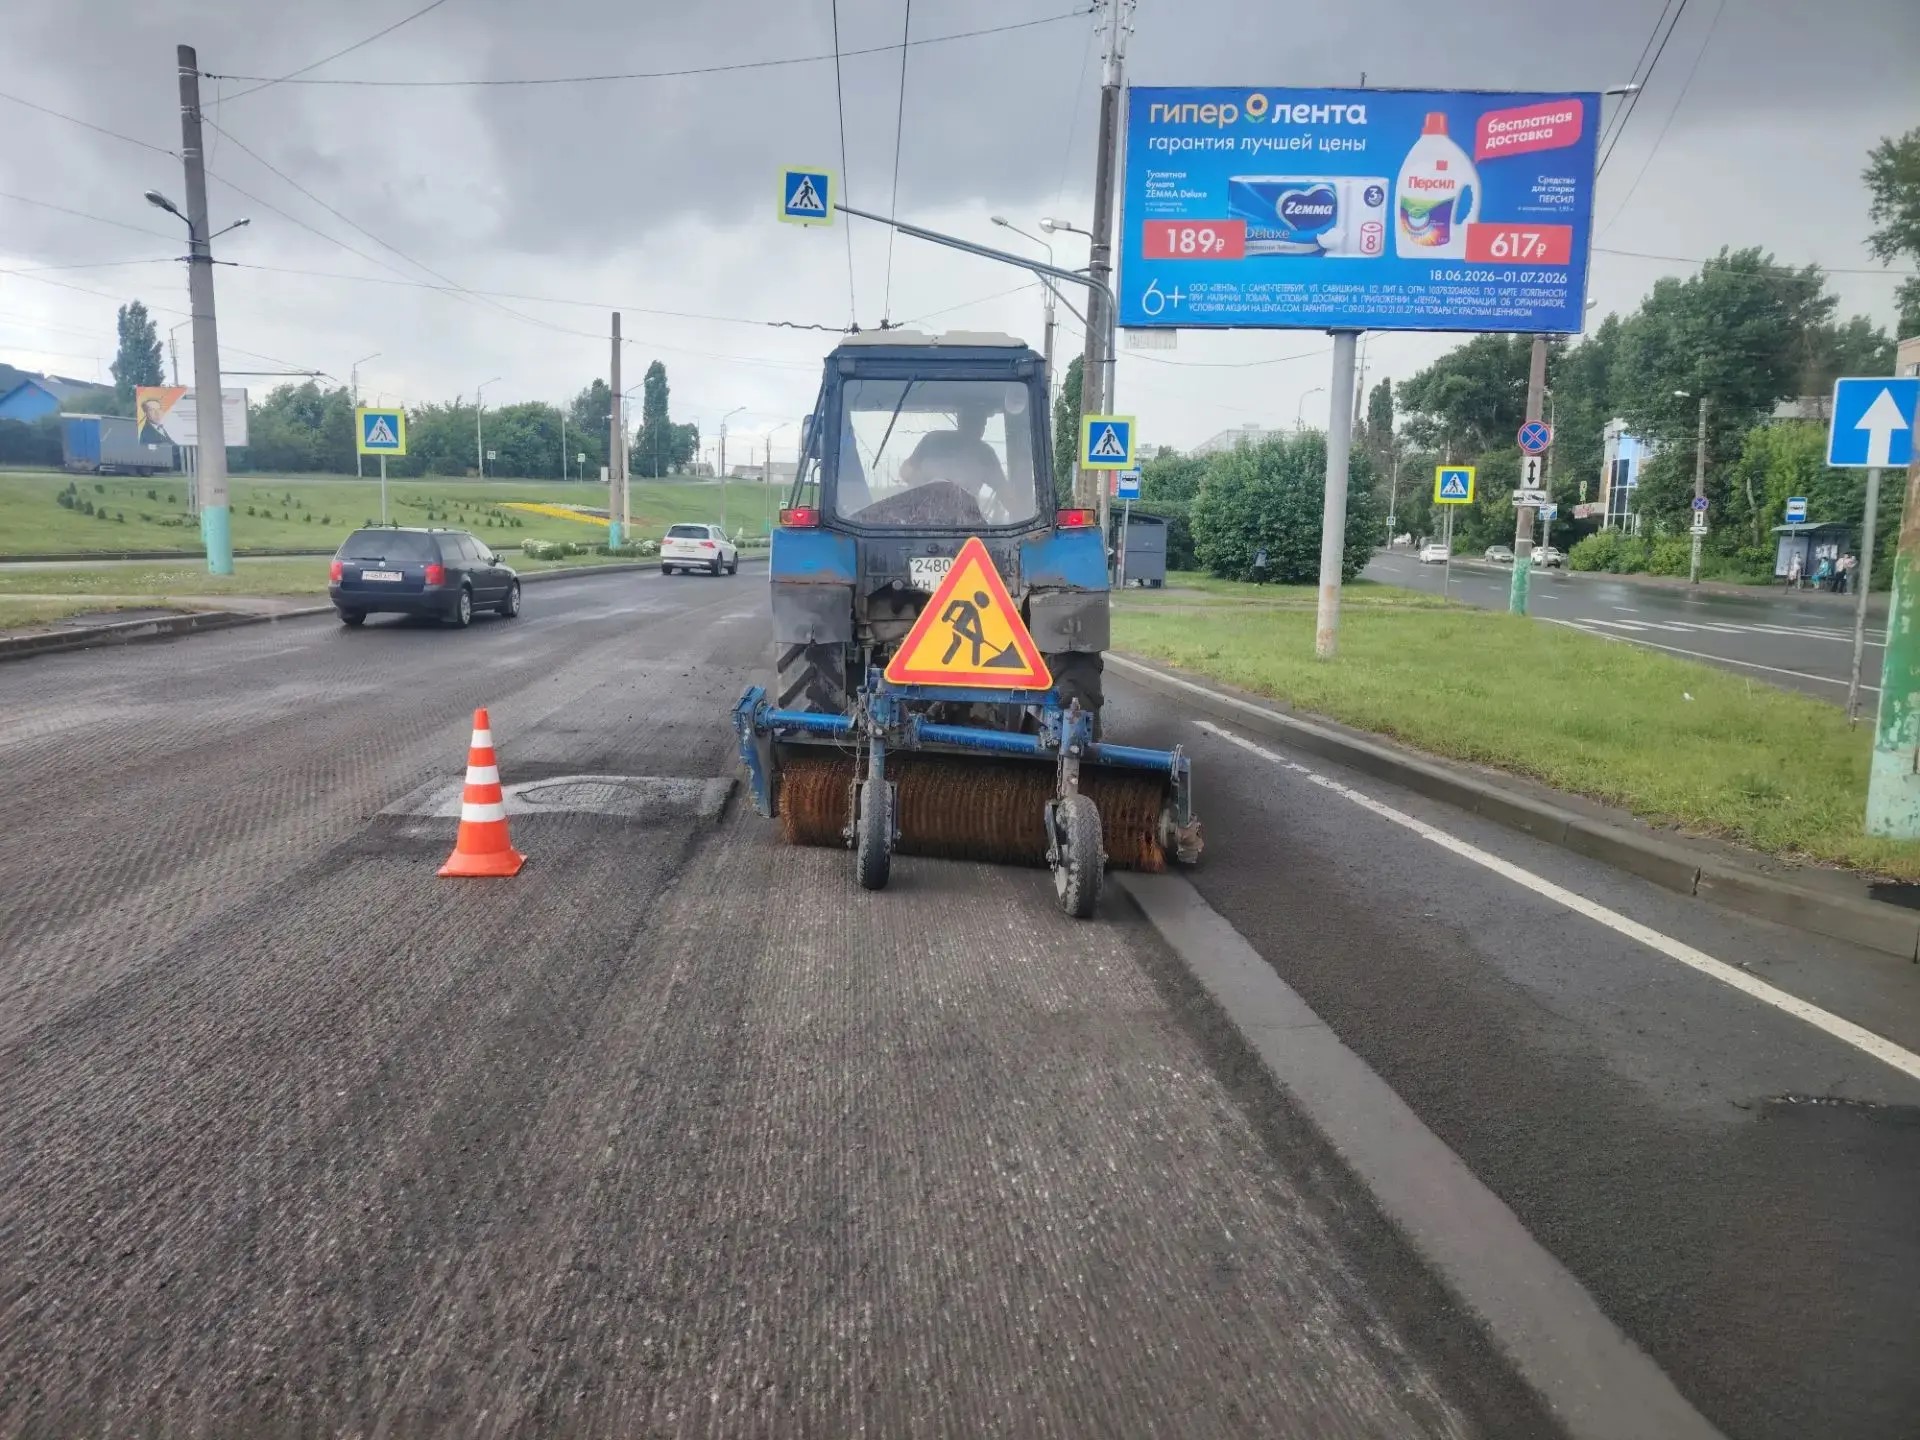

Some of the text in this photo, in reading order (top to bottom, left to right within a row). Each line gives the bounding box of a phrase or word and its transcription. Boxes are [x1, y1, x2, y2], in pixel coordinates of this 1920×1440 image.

[1150, 103, 1367, 129] гипер лента
[1487, 111, 1573, 134] бесплатная
[1149, 133, 1366, 155] гарантия лучшей цены
[1485, 128, 1553, 150] доставка
[1145, 169, 1187, 180] Туалетная
[1537, 175, 1576, 186] Средство
[1145, 181, 1175, 189] бумага
[1408, 176, 1455, 191] Персил
[1532, 185, 1575, 194] для стирки
[1145, 189, 1208, 199] ZEMMA Deluxe
[1538, 194, 1575, 204] ПЕРСИЛ
[1245, 227, 1290, 240] Deluxe
[1366, 235, 1376, 250] 8
[1188, 283, 1208, 292] ООО
[1142, 278, 1187, 315] 6+
[915, 559, 951, 573] 2480
